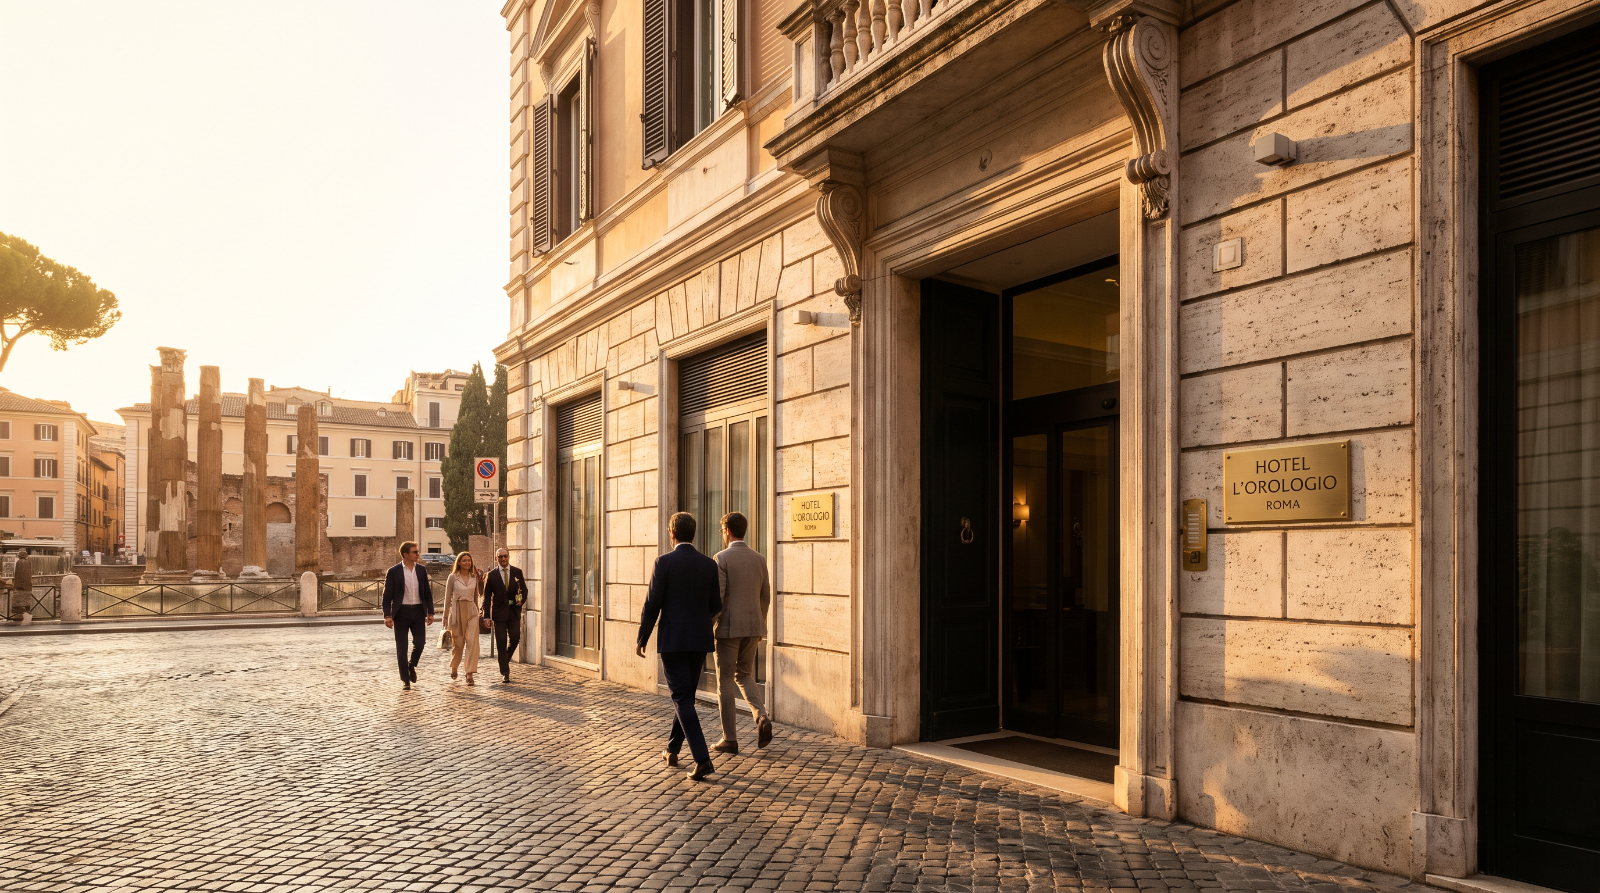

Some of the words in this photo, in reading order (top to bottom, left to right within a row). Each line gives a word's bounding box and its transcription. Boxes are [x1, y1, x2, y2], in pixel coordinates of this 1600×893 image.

[1256, 457, 1311, 474] HOTEL
[1233, 475, 1337, 495] L'OROLOGIO
[801, 500, 821, 510] HOTEL
[1266, 500, 1301, 510] ROMA
[793, 511, 830, 522] L'OROLOGIO
